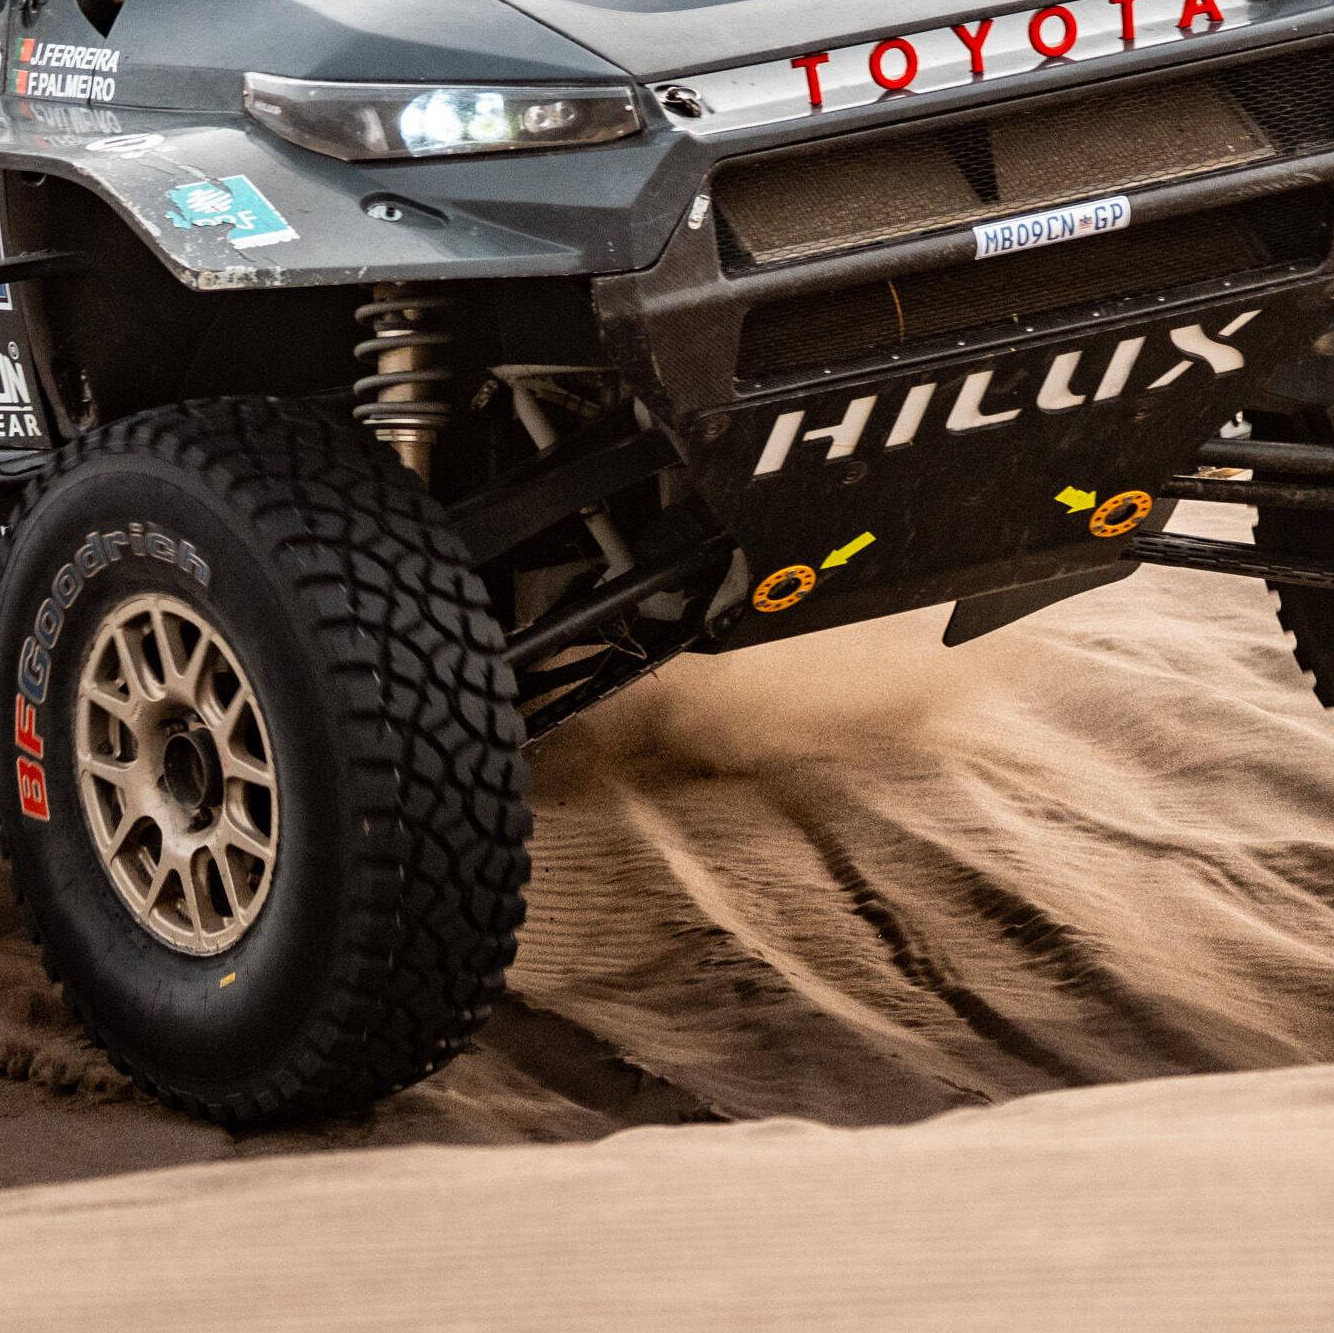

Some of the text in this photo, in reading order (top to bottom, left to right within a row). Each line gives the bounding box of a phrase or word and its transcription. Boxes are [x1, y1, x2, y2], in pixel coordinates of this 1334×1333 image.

[30, 42, 121, 73] J.FERREIRA
[27, 72, 116, 101] F.PALMEIRO
[984, 203, 1124, 255] MB09CN GP
[753, 309, 1262, 477] HILUX
[14, 521, 212, 823] BFGoodrich
